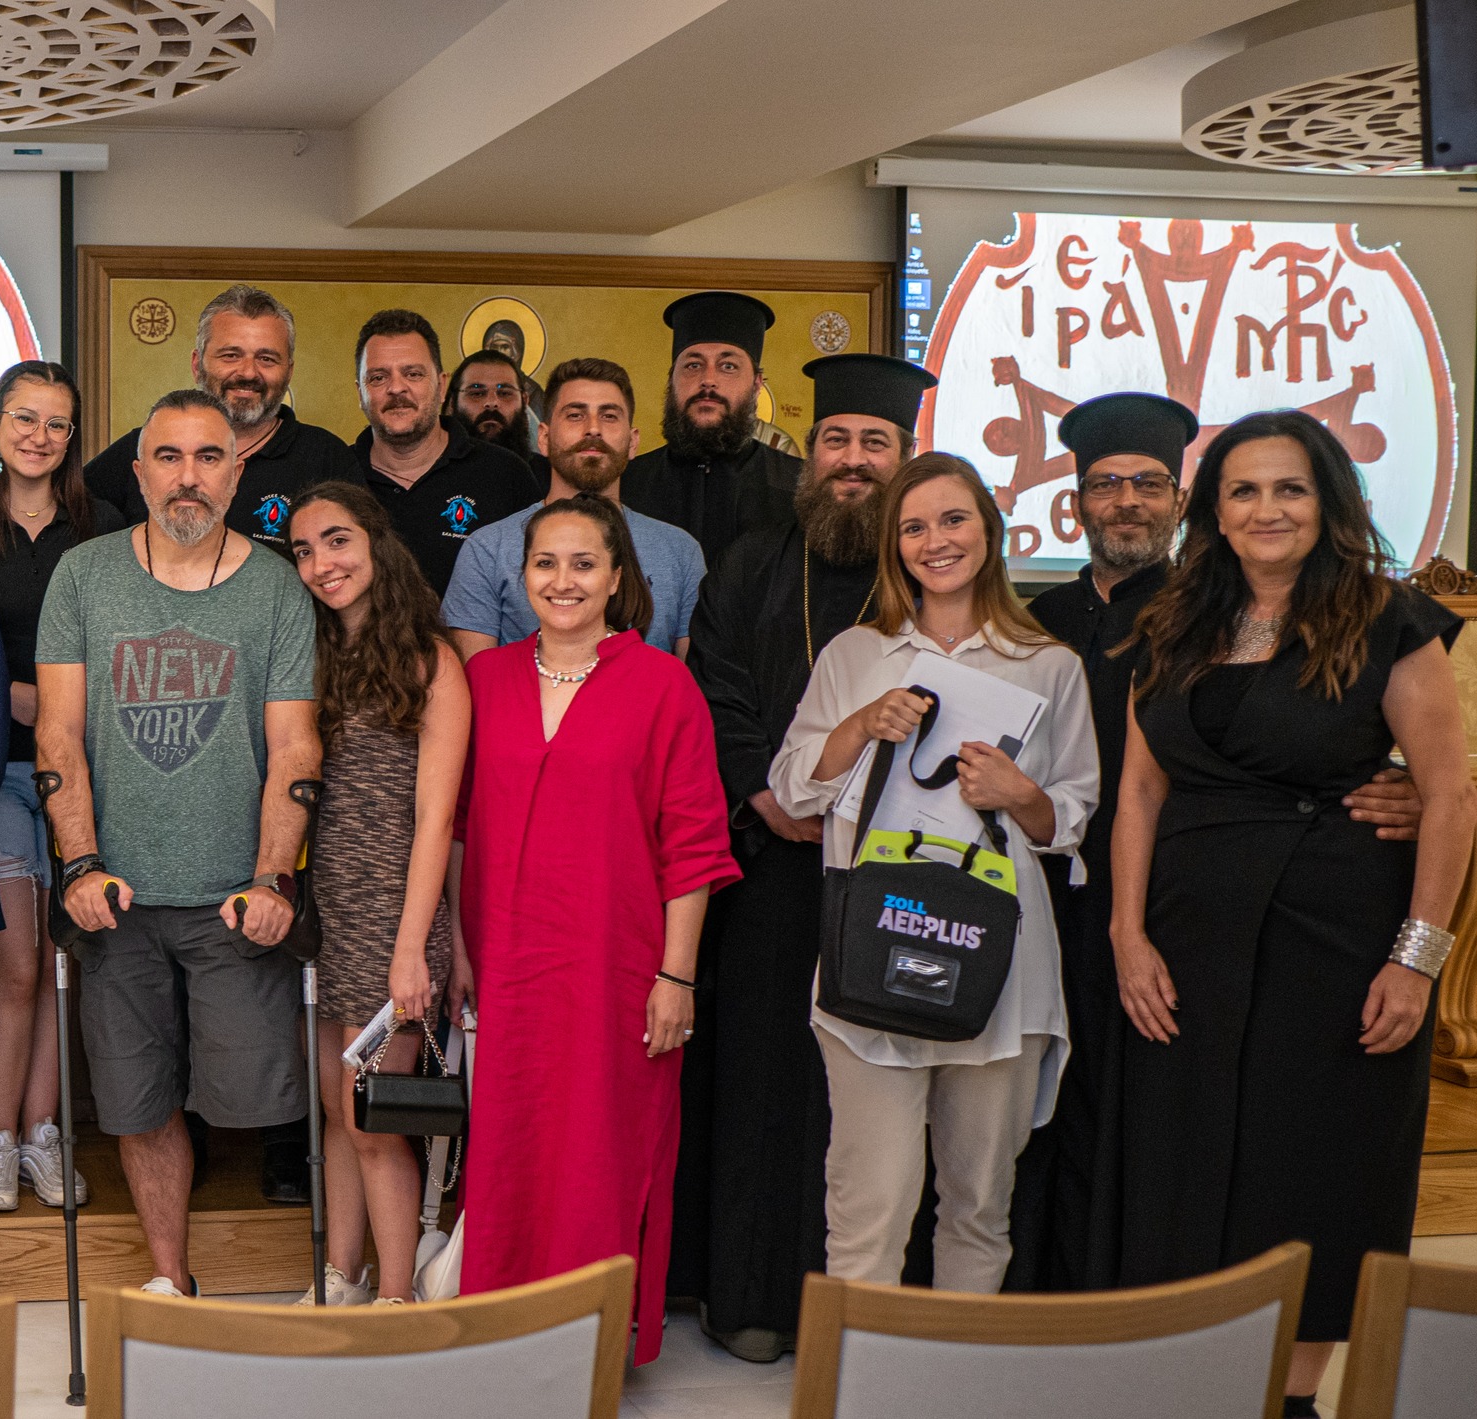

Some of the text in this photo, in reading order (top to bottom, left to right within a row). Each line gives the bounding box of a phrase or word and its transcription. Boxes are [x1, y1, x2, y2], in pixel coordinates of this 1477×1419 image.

[119, 644, 230, 701] NEW
[127, 704, 209, 747] YORK
[152, 745, 188, 765] 1979
[883, 893, 927, 915] ZOLL
